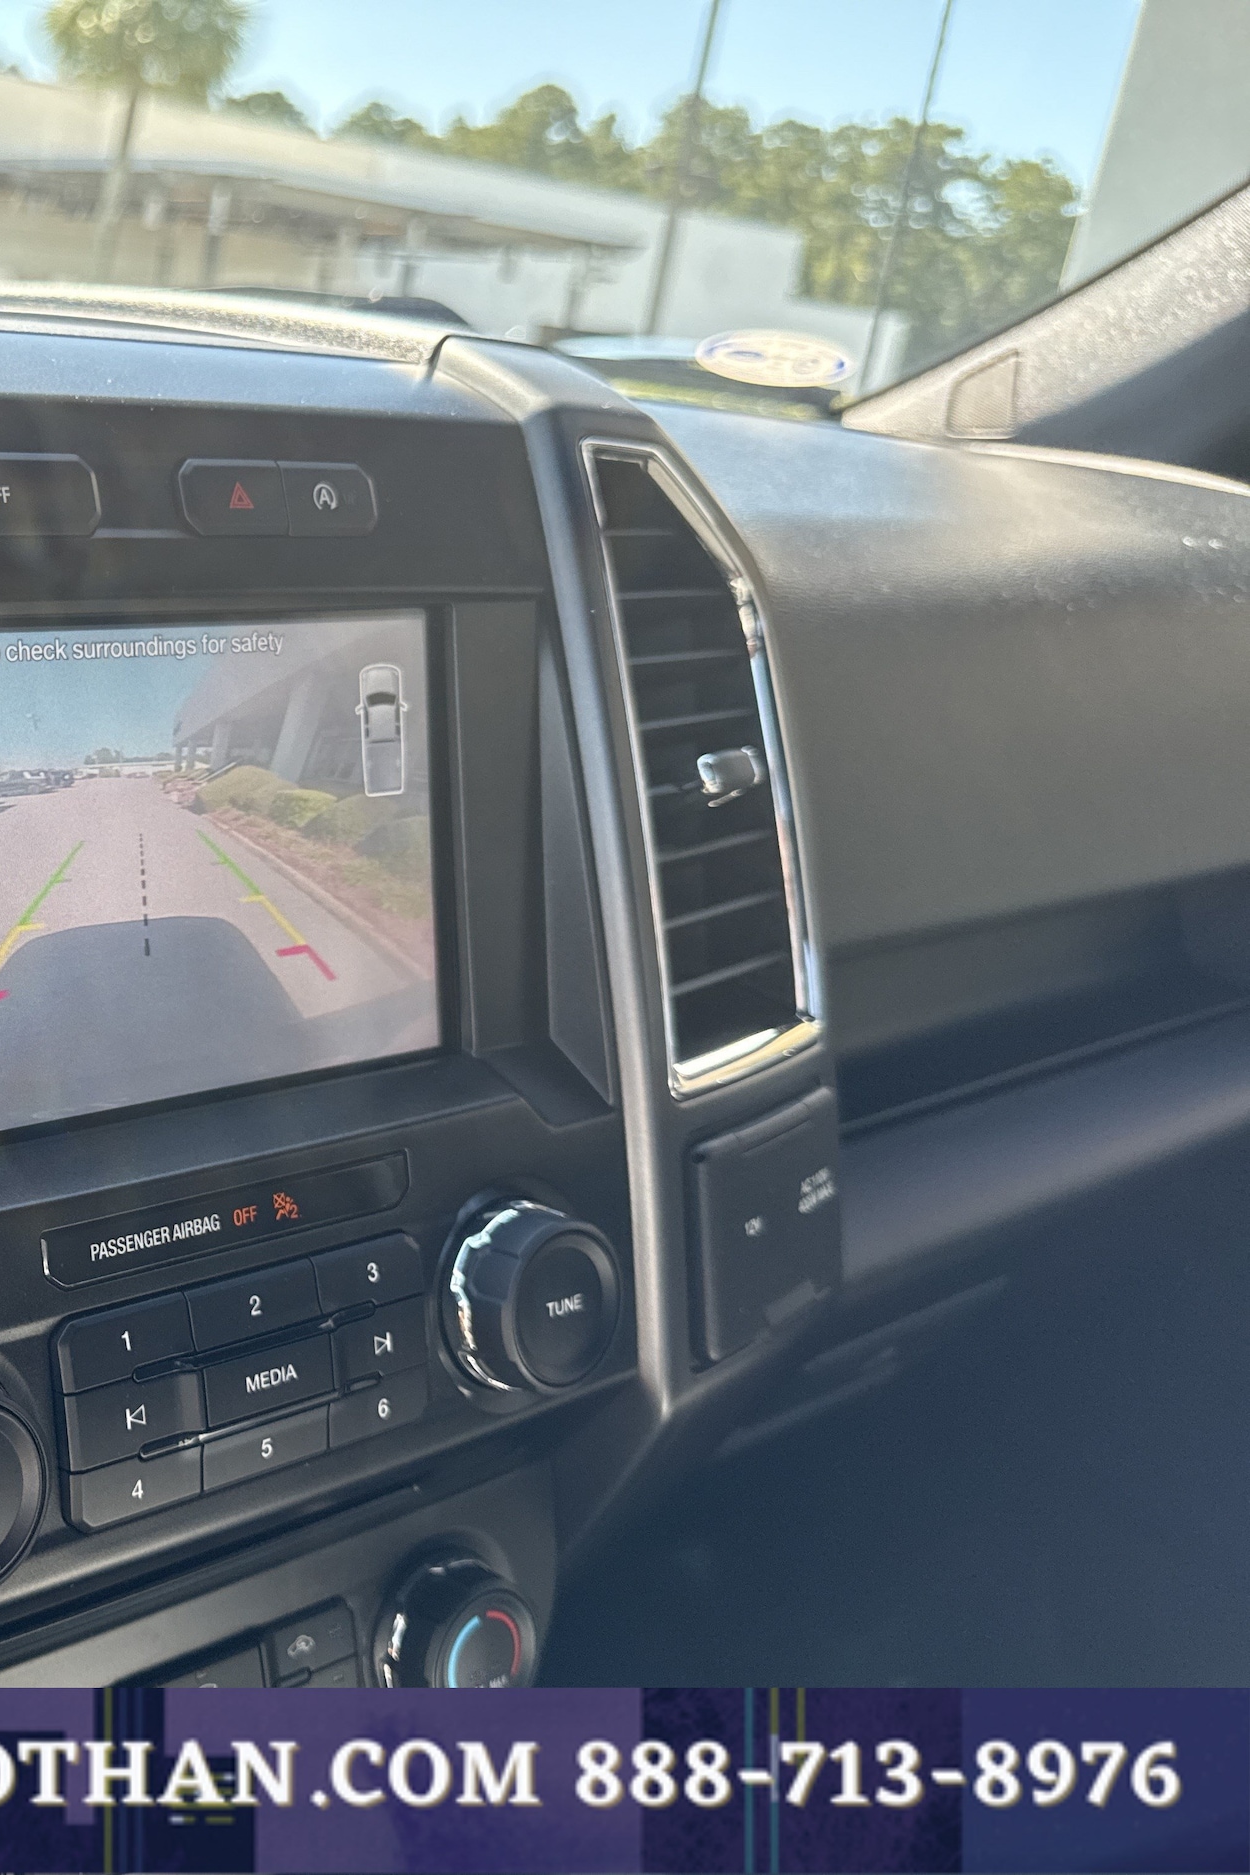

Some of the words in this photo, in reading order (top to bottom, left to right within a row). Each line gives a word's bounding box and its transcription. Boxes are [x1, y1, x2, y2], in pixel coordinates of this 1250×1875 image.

[5, 637, 68, 662] check
[72, 634, 197, 660] surroundings
[201, 633, 227, 654] for
[231, 632, 284, 655] safety
[90, 1225, 171, 1262] PASSENGER
[172, 1213, 221, 1241] AIRBAG
[232, 1205, 258, 1227] OFF
[367, 1261, 379, 1283] 3
[249, 1294, 262, 1316] 2
[546, 1292, 583, 1319] TUNE
[121, 1330, 132, 1352] 1
[245, 1363, 298, 1394] MEDIA
[377, 1396, 390, 1418] 6
[261, 1437, 273, 1459] 5
[131, 1479, 144, 1501] 4
